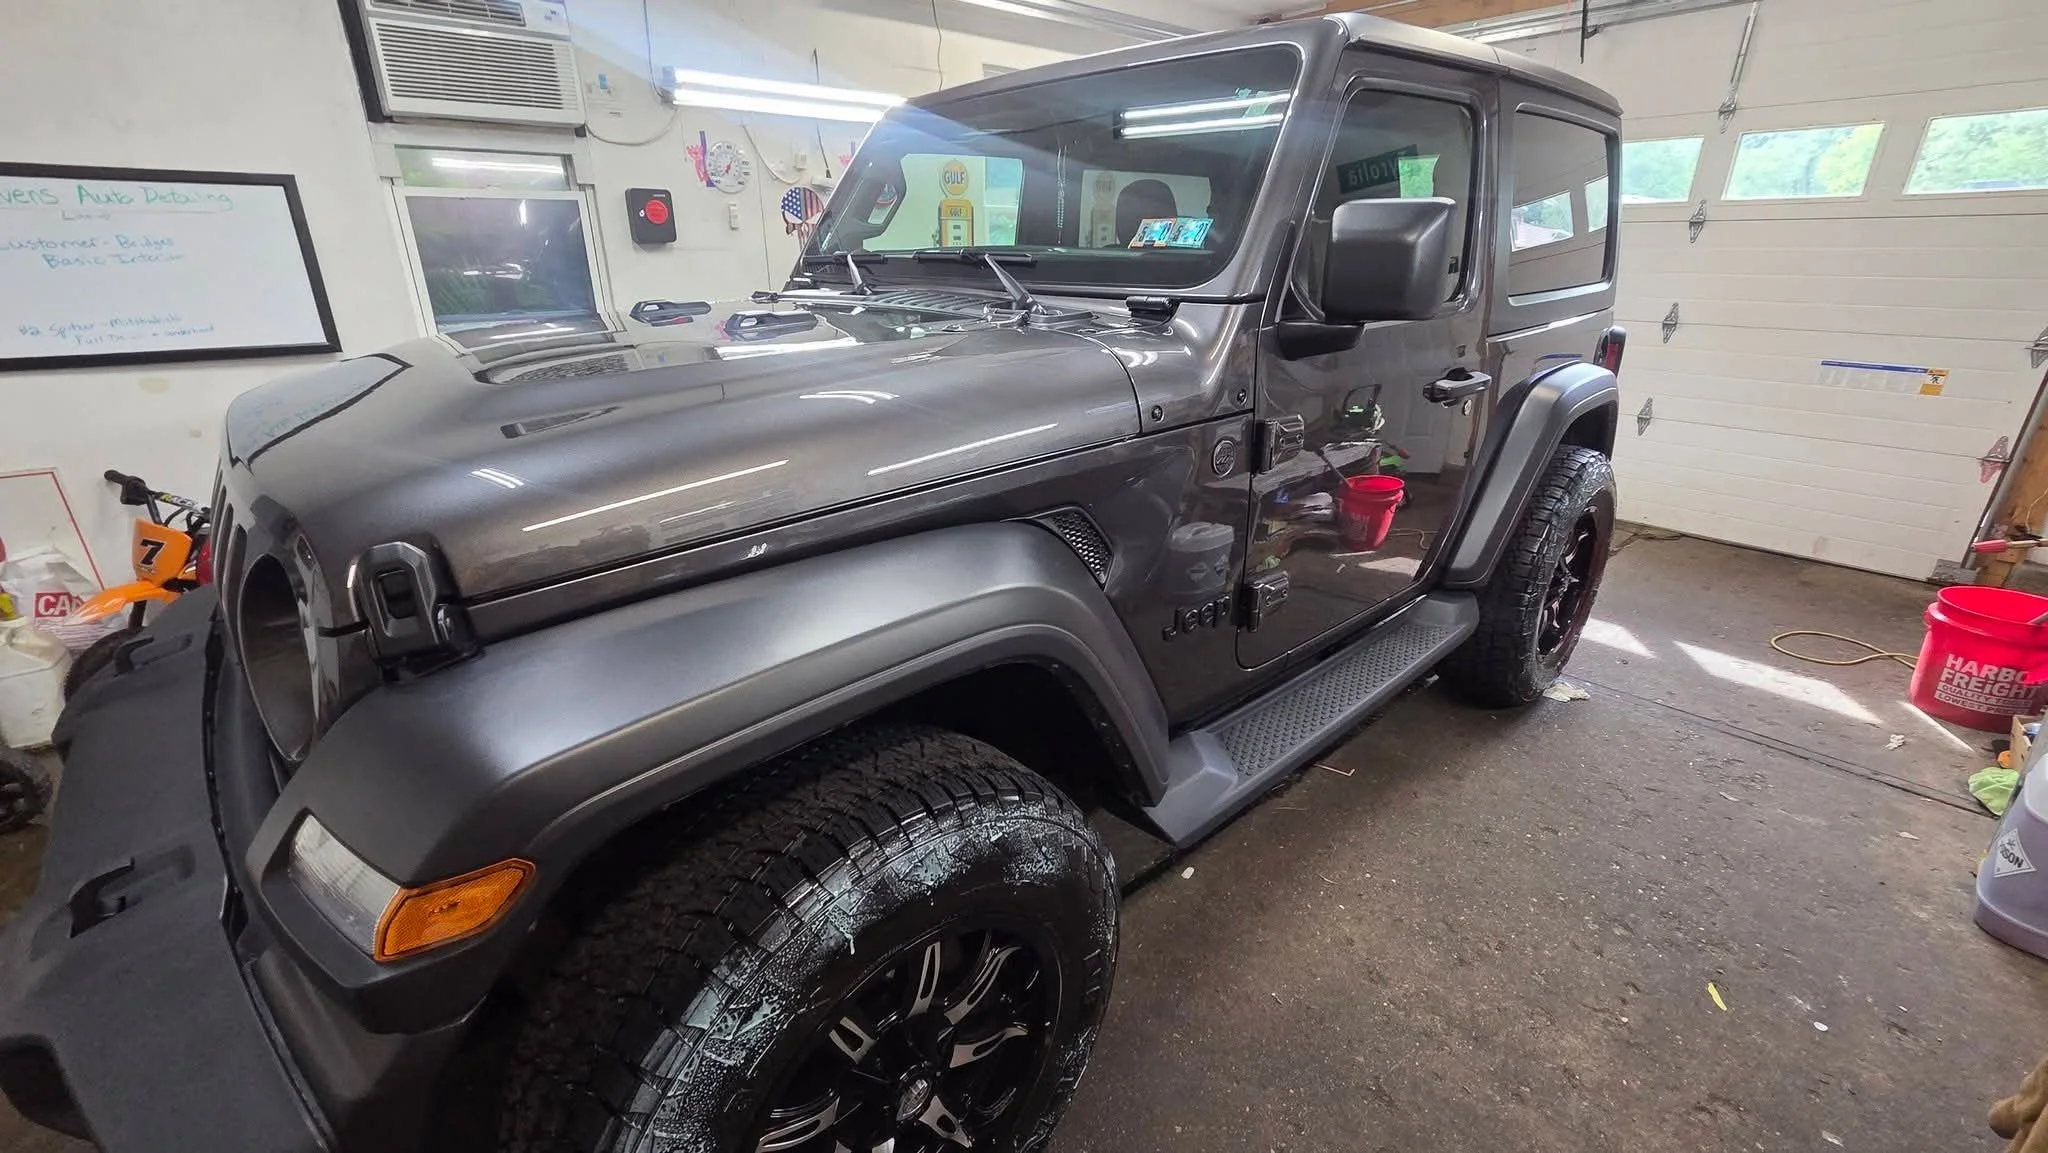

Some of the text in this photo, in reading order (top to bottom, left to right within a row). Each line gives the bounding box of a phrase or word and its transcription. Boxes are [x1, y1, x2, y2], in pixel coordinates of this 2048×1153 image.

[944, 171, 965, 184] GULF
[77, 184, 133, 205] Auto
[0, 238, 98, 251] ustomer
[139, 538, 166, 566] 7
[1946, 654, 2031, 684] HARBO
